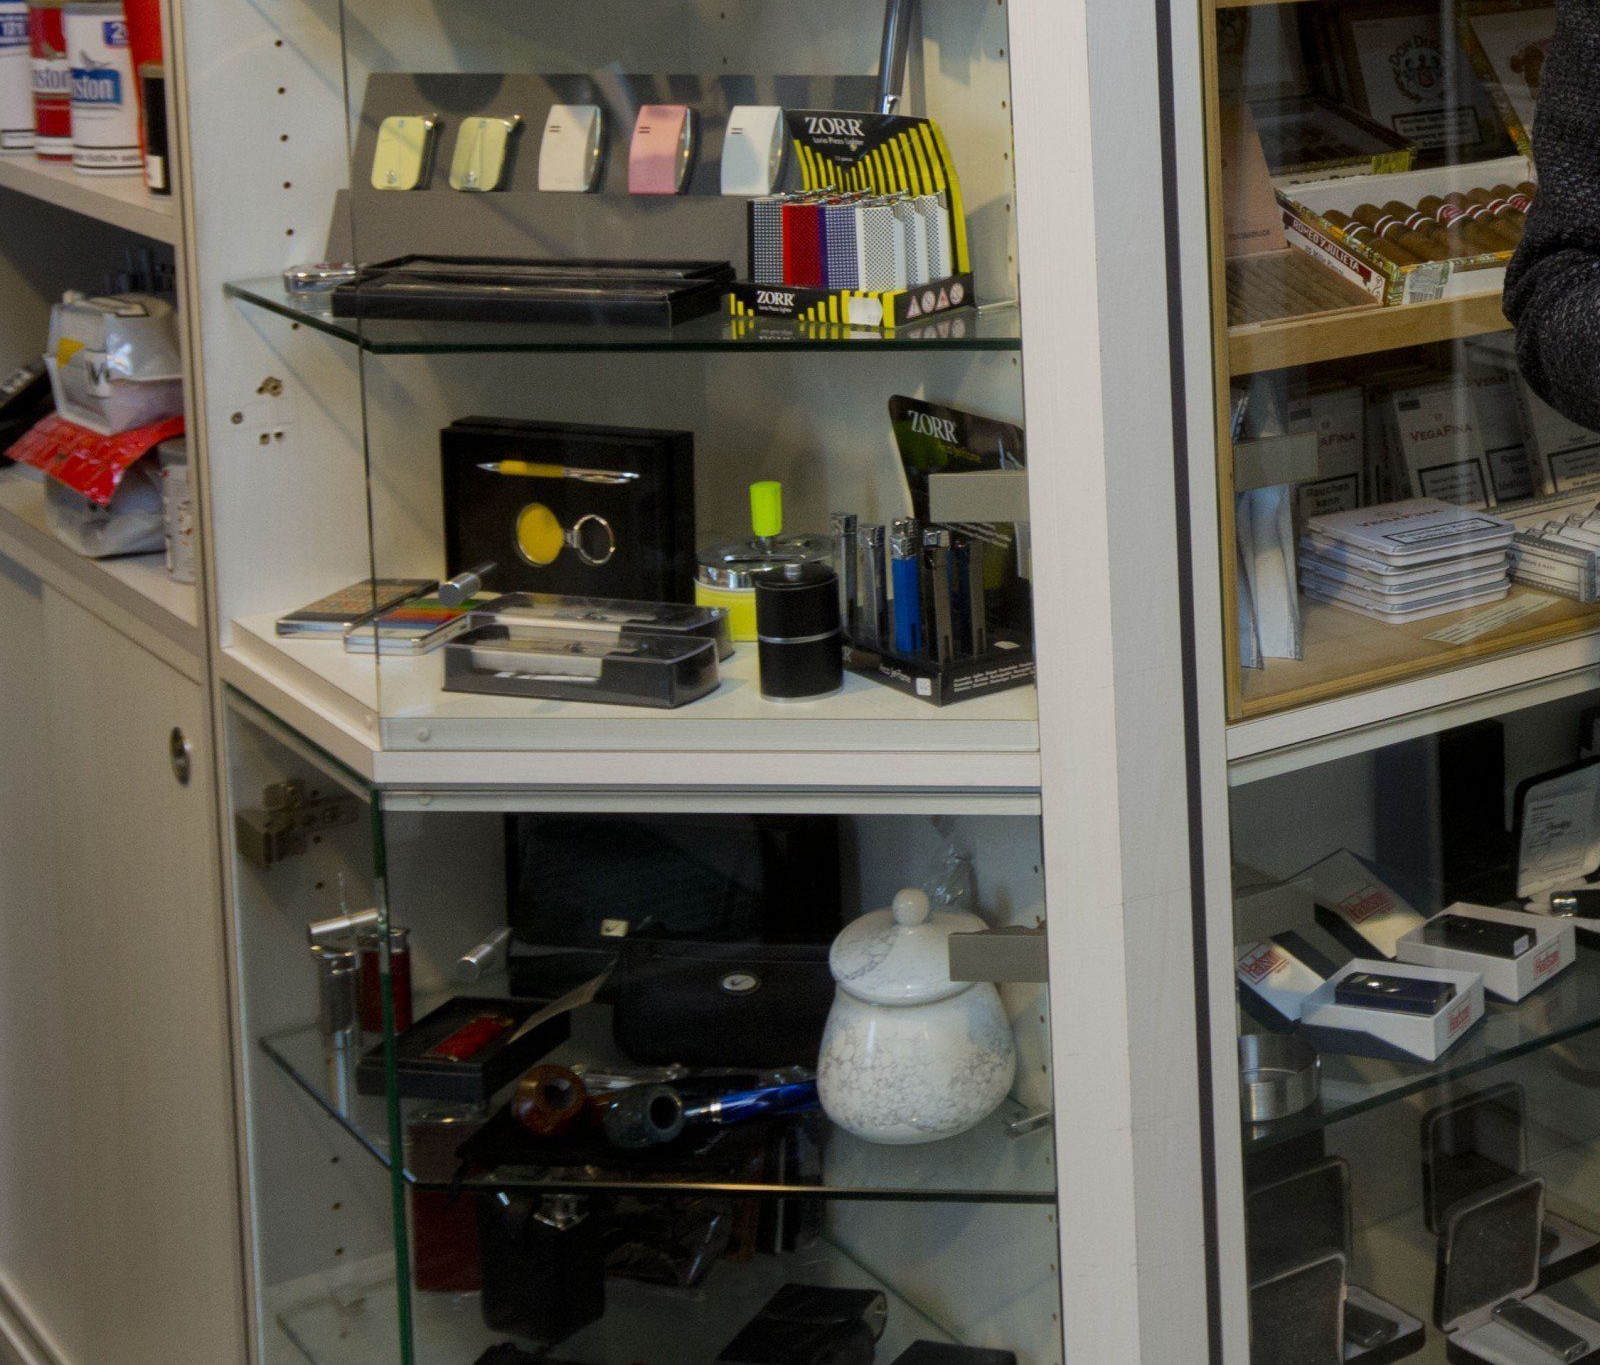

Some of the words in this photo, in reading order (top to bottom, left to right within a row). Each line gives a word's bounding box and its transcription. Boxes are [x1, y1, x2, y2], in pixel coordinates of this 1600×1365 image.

[804, 116, 866, 137] ZORR
[1292, 218, 1320, 245] ROMEO
[1325, 242, 1360, 275] JULIETA
[757, 291, 795, 307] ZORR
[907, 410, 959, 445] ZORR
[1410, 424, 1473, 443] VEGAFINA
